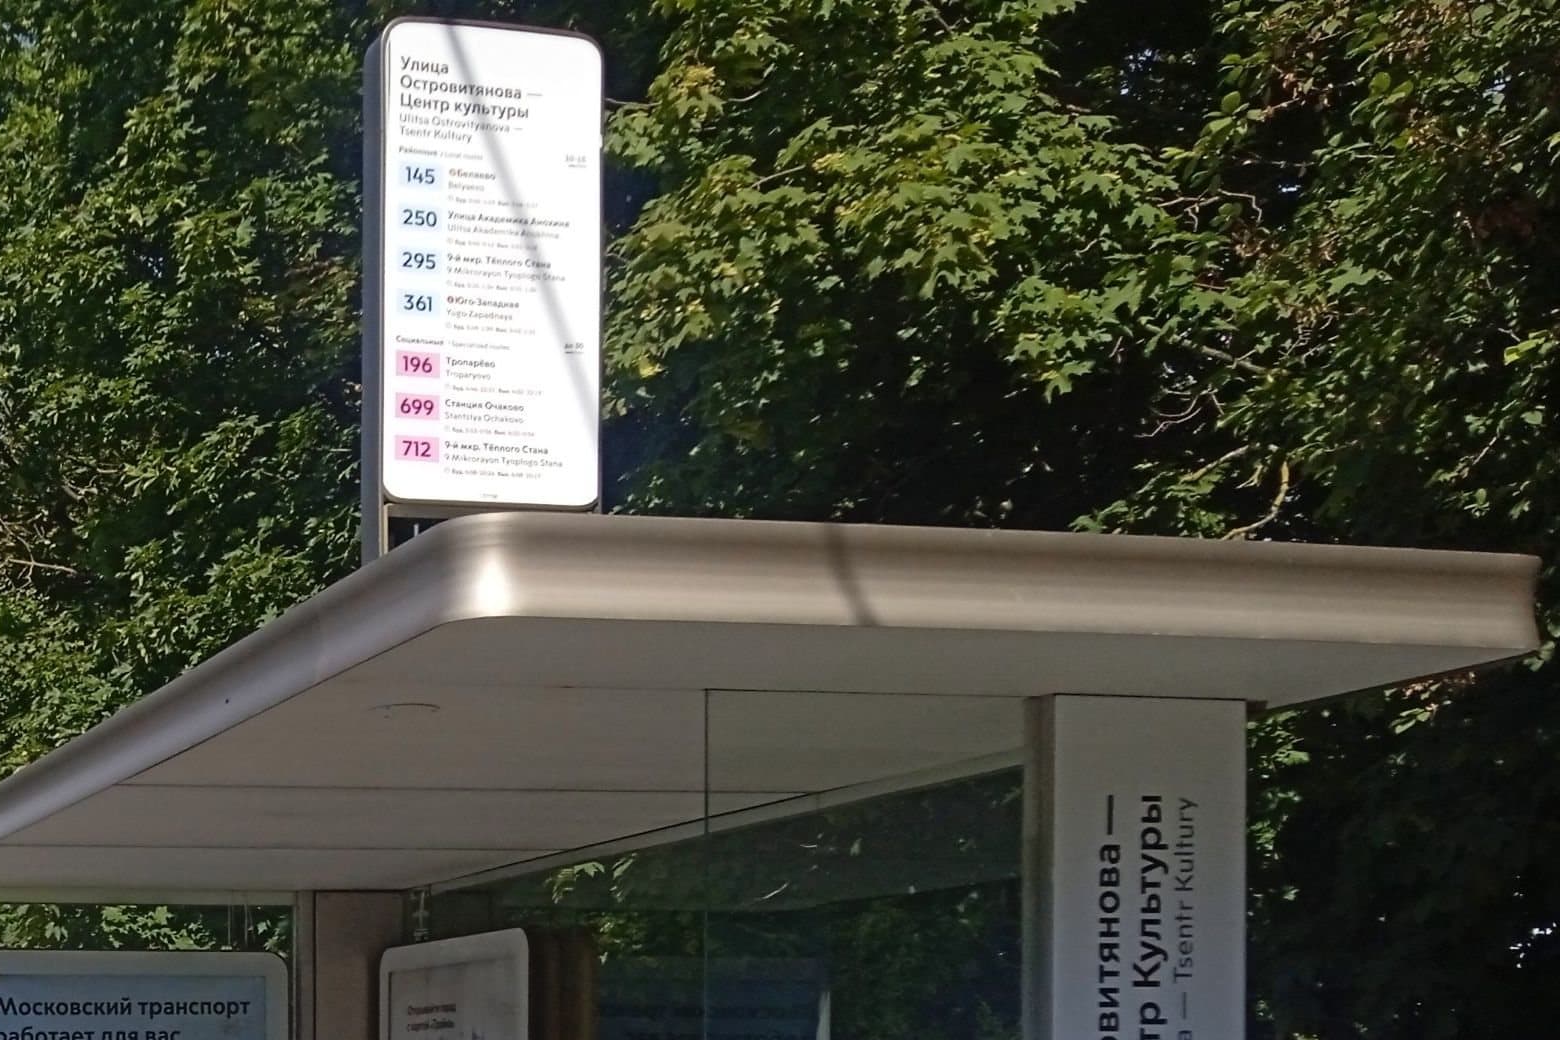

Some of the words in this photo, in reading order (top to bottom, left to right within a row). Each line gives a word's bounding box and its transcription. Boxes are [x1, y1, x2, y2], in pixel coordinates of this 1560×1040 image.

[400, 55, 449, 75] Улица
[400, 74, 522, 99] Островитянова
[400, 92, 450, 113] Центр
[454, 102, 529, 120] культуры
[399, 113, 430, 126] Ulitsa
[431, 115, 510, 133] Ostrovityanova
[400, 125, 432, 137] Tsentr
[433, 129, 472, 144] Kultury
[405, 166, 436, 185] 145
[402, 209, 437, 228] 250
[402, 252, 436, 270] 295
[403, 294, 433, 312] 361
[402, 355, 433, 374] 196
[446, 356, 496, 369] Тропарёво
[400, 398, 434, 416] 699
[444, 398, 483, 410] Станция
[484, 401, 525, 412] Очаково
[402, 440, 432, 458] 712
[444, 440, 459, 451] 9-й
[483, 442, 520, 454] Тёплого
[522, 445, 549, 455] Стана
[1174, 798, 1198, 892] Kultury
[1131, 795, 1169, 988] Культуры
[1174, 902, 1193, 984] Tsentr
[138, 999, 250, 1019] транспорт
